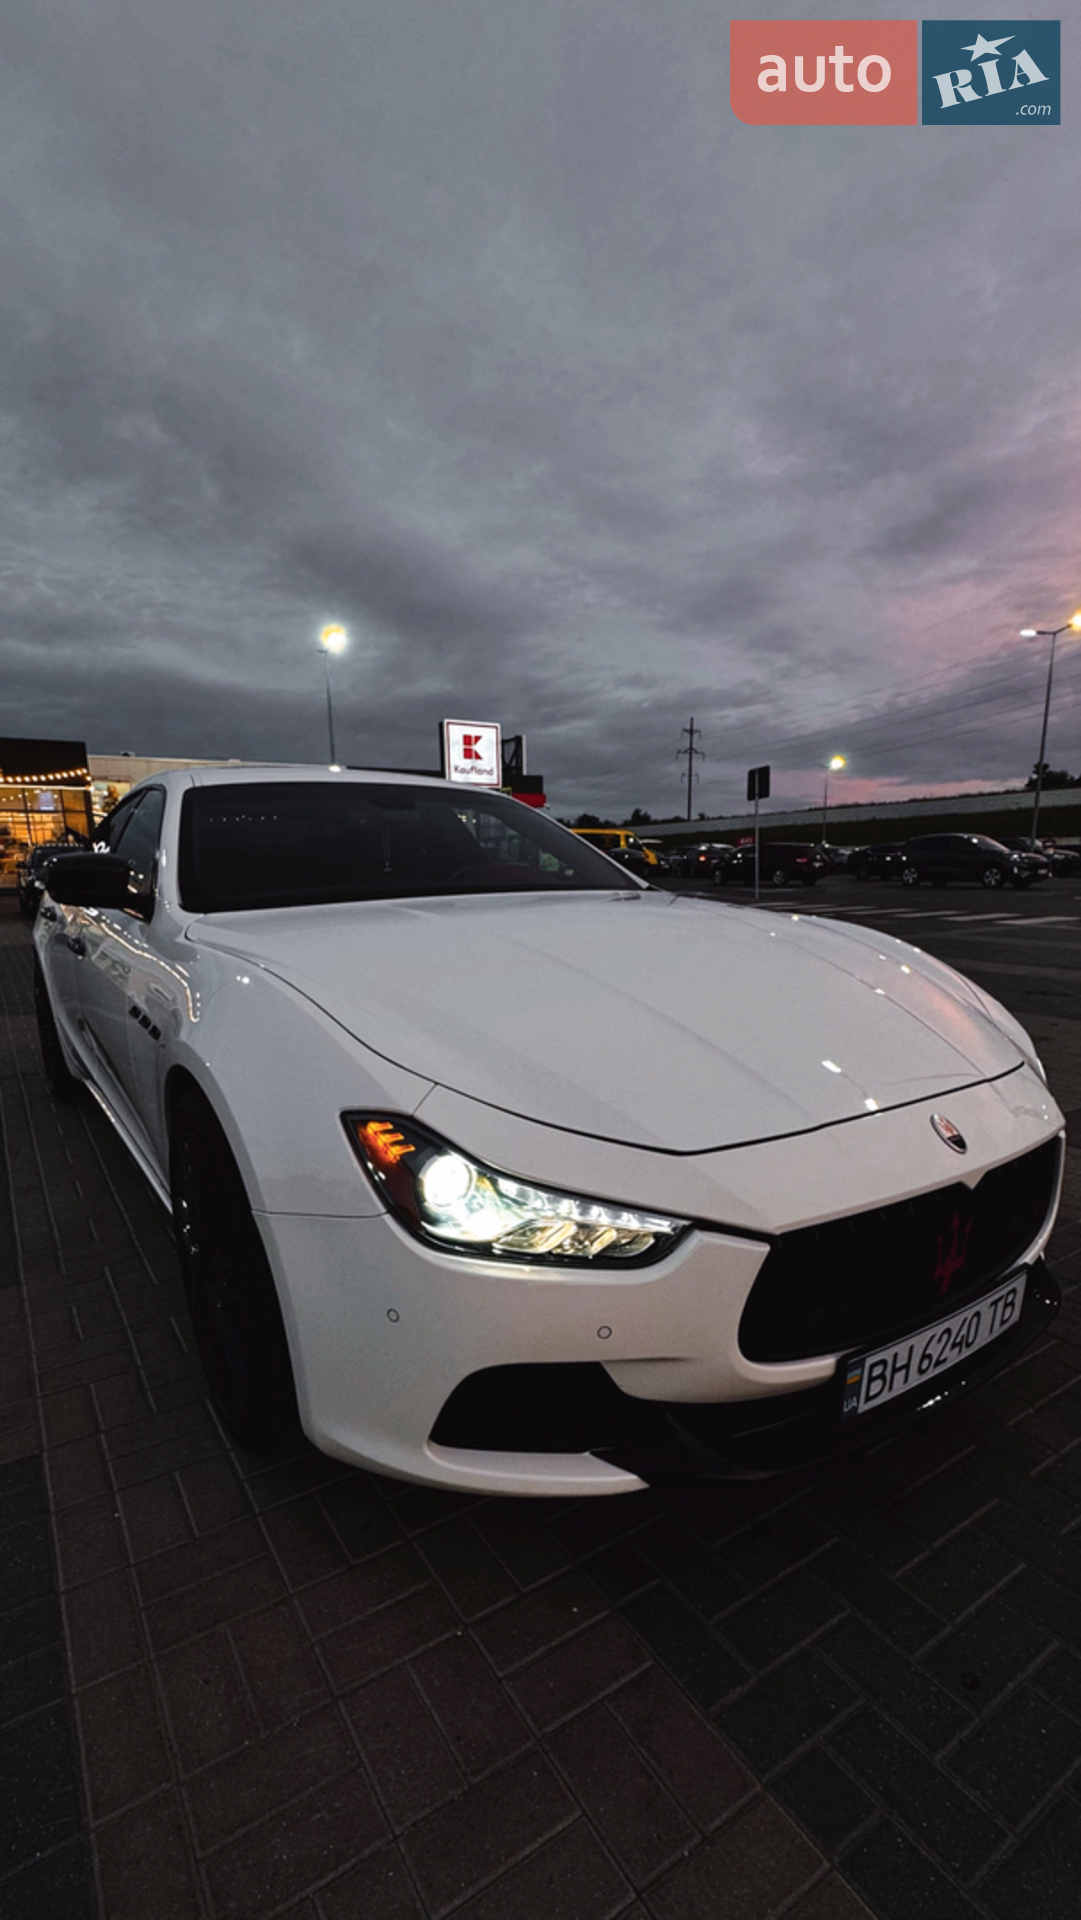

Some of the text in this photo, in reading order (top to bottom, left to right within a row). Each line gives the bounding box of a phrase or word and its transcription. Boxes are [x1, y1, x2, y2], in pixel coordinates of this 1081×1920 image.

[453, 764, 495, 776] Kaufland
[864, 1287, 1018, 1404] BH 6240 TB
[843, 1395, 858, 1412] UA
